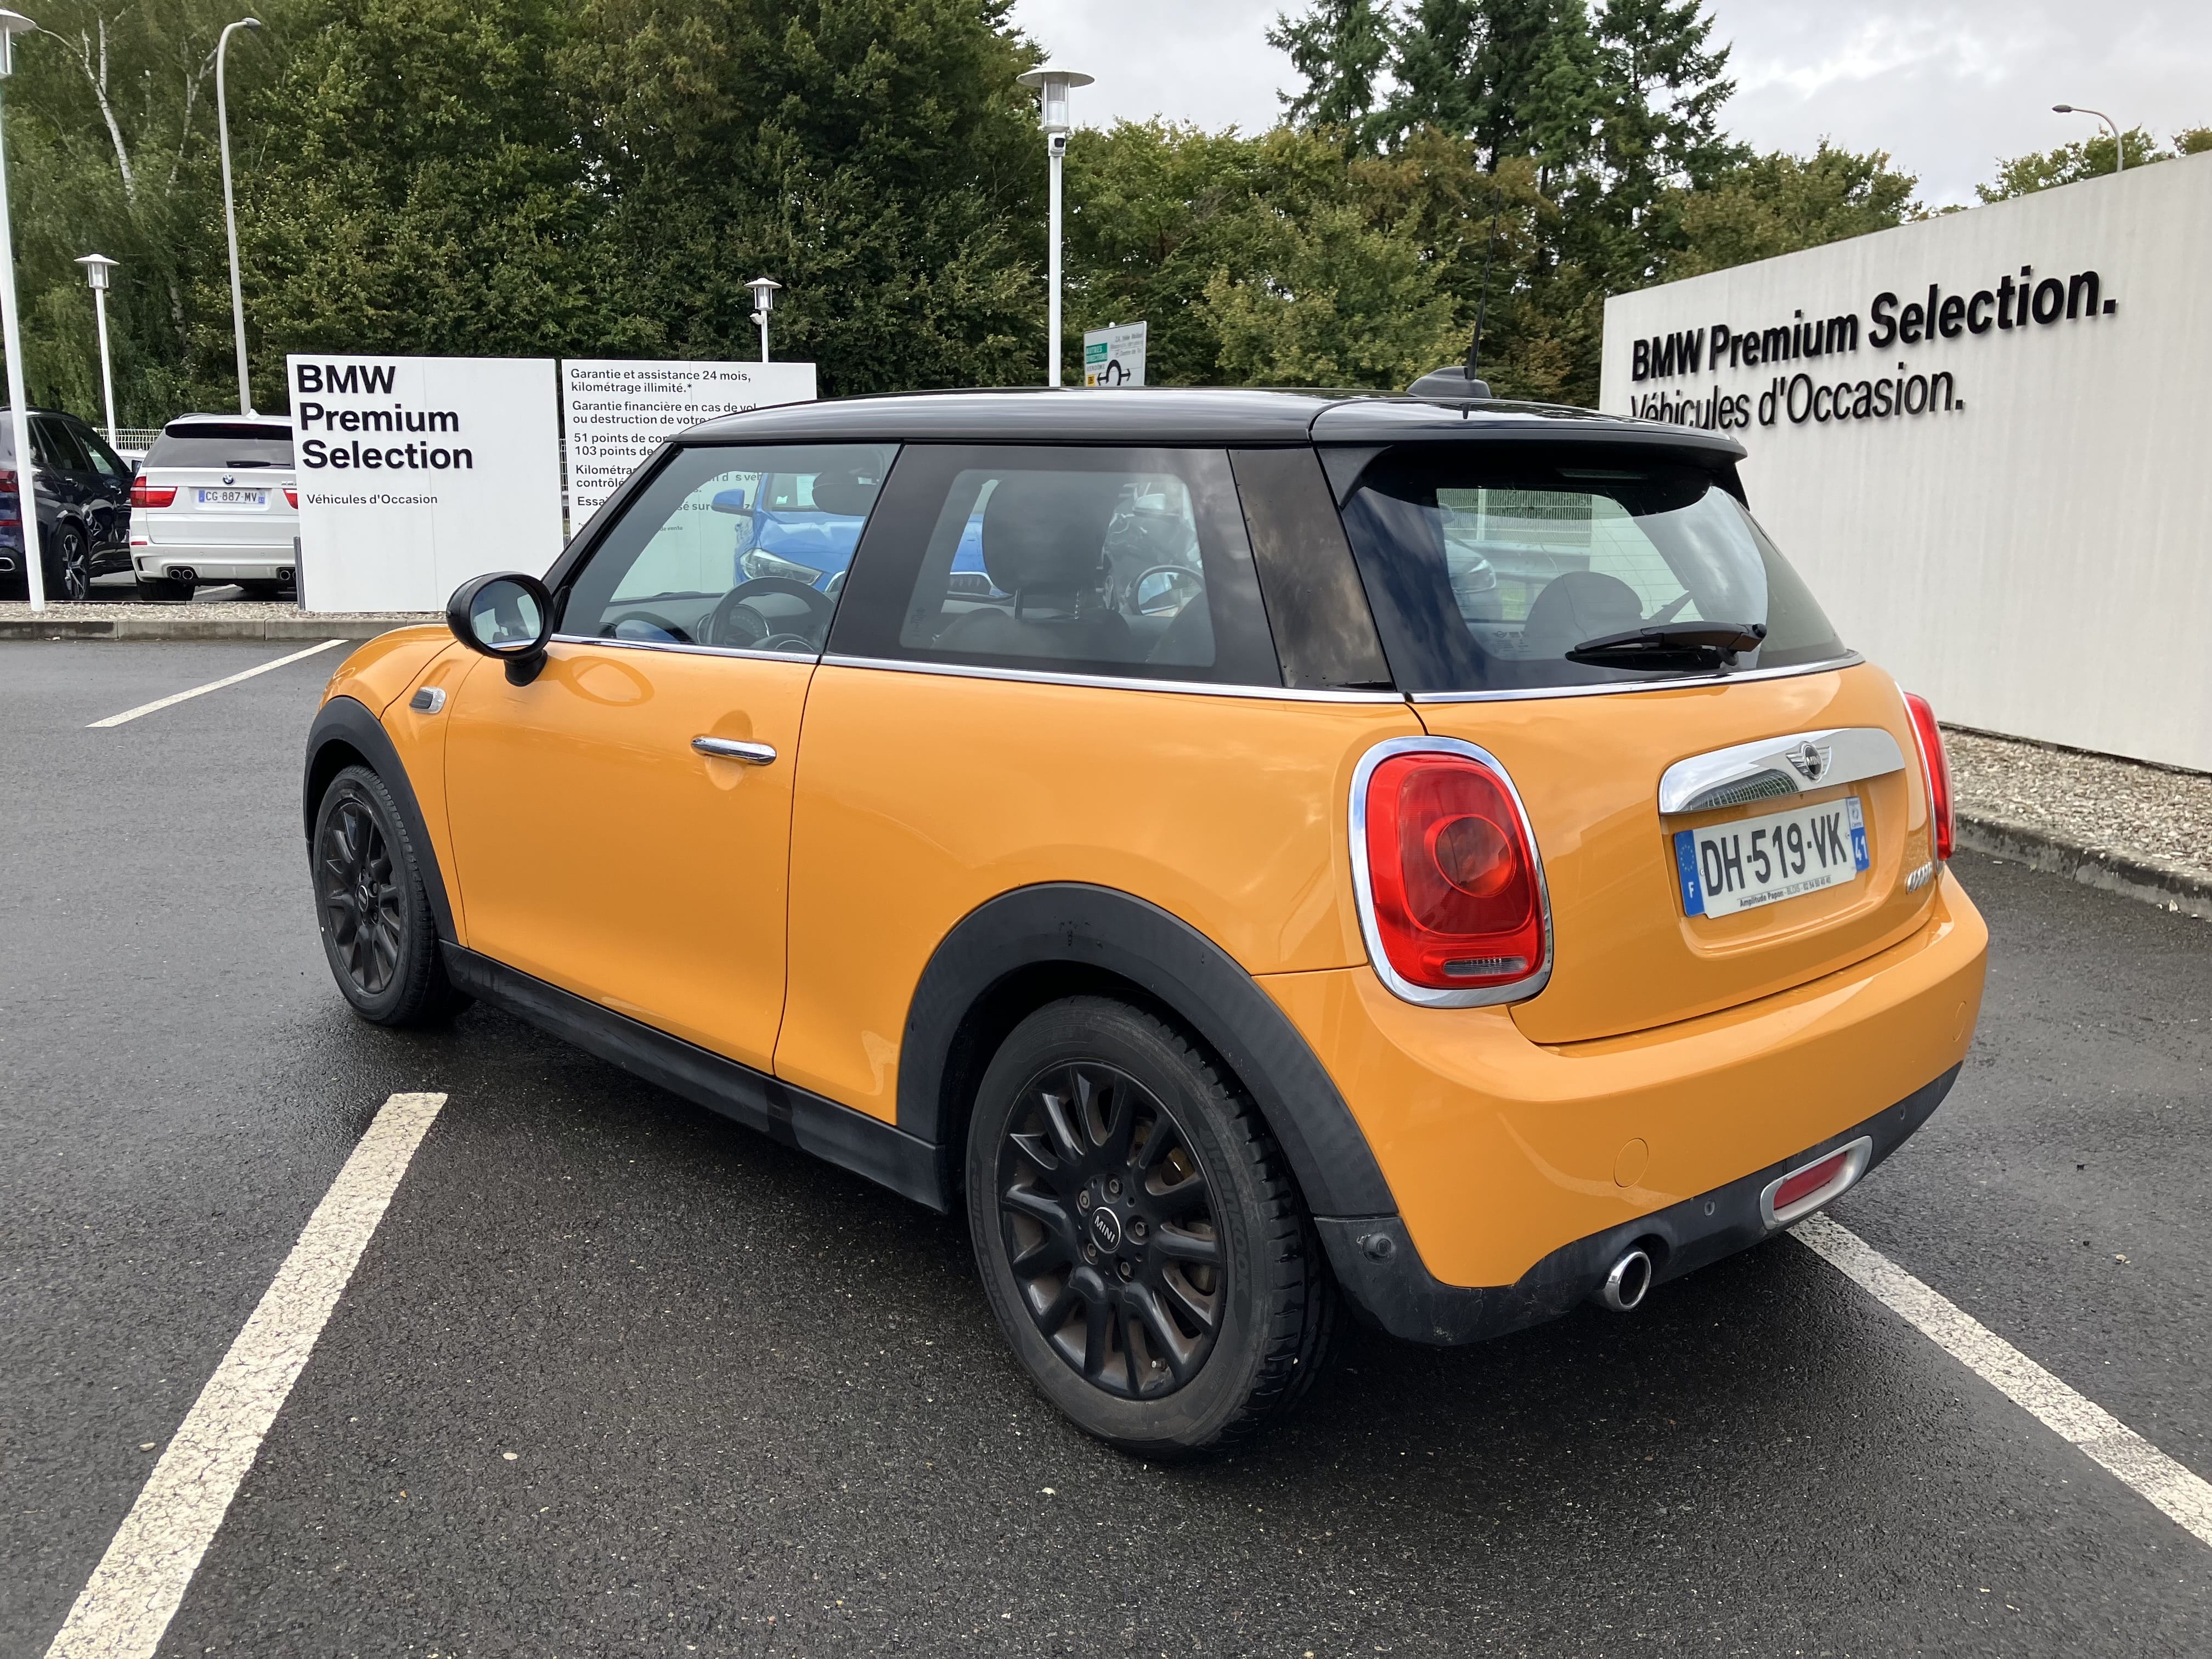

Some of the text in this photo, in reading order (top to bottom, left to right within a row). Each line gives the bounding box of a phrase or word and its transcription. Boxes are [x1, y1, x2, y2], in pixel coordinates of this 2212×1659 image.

[1632, 265, 2117, 381] BMW Premium Selection.
[297, 364, 396, 394] BMW
[571, 369, 751, 382] Garantie et assistance 24 mois,
[571, 381, 641, 394] kilométrage
[1631, 362, 1965, 430] Véhicules d'Occasion.
[572, 401, 622, 411] Garantie
[625, 401, 681, 412] financière
[724, 403, 737, 412] de
[300, 402, 459, 432] Premium
[590, 414, 657, 425] destruction
[660, 414, 674, 425] de
[574, 433, 587, 442] 51
[592, 433, 628, 444] points
[631, 433, 645, 443] de
[302, 440, 473, 469] Selection
[575, 446, 653, 457] 103 points de
[307, 494, 438, 504] Véhicules d'Occasion
[1688, 812, 1867, 899] F DH-519-VK 41
[1740, 895, 1767, 907] Amplitude
[1768, 890, 1783, 900] Papon
[1094, 1215, 1115, 1243] MINI
